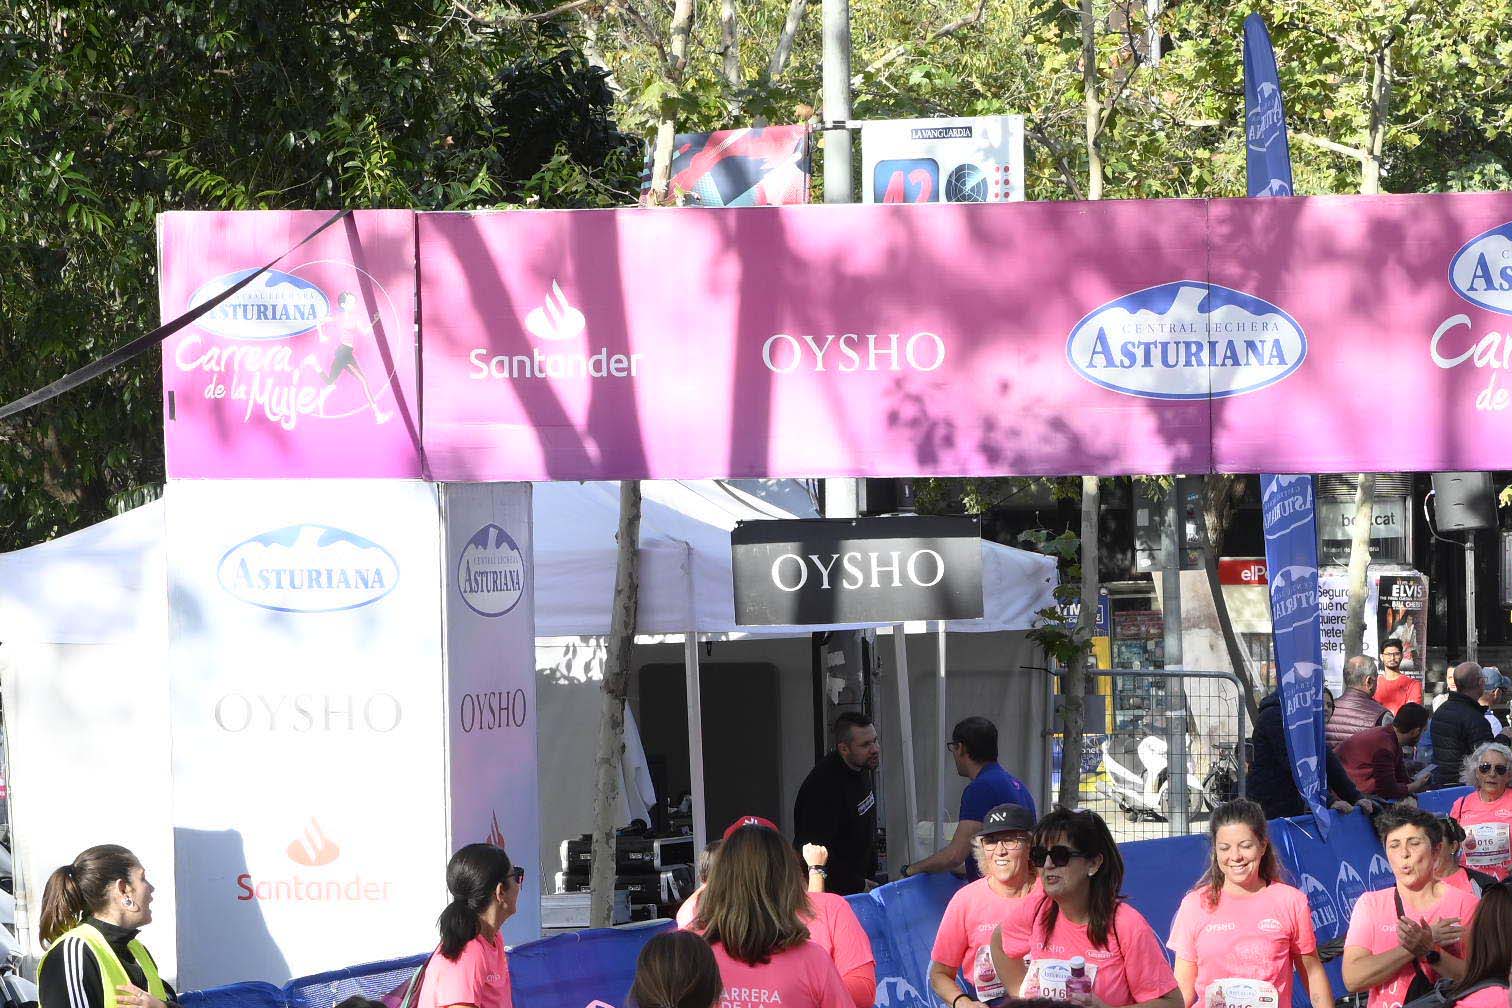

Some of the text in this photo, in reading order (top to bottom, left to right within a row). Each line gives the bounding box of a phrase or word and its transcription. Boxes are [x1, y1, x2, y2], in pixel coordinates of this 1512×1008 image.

[922, 127, 971, 139] VANGUARDIA
[1122, 322, 1281, 336] CENTRAL LECHERA
[176, 335, 297, 373] Carrera
[468, 346, 644, 379] Santander
[762, 332, 946, 373] OYSHO
[1087, 326, 1287, 369] ASTURIANA
[204, 374, 227, 399] de
[243, 370, 336, 430] Mujer
[1476, 382, 1510, 412] de
[234, 556, 386, 590] ASTURIANA
[463, 560, 522, 594] ASTURIANA
[771, 549, 946, 592] OYSHO
[214, 692, 403, 733] OYSHO
[460, 688, 527, 733] OYSHO
[237, 873, 393, 901] Santander
[1043, 987, 1066, 999] 016
